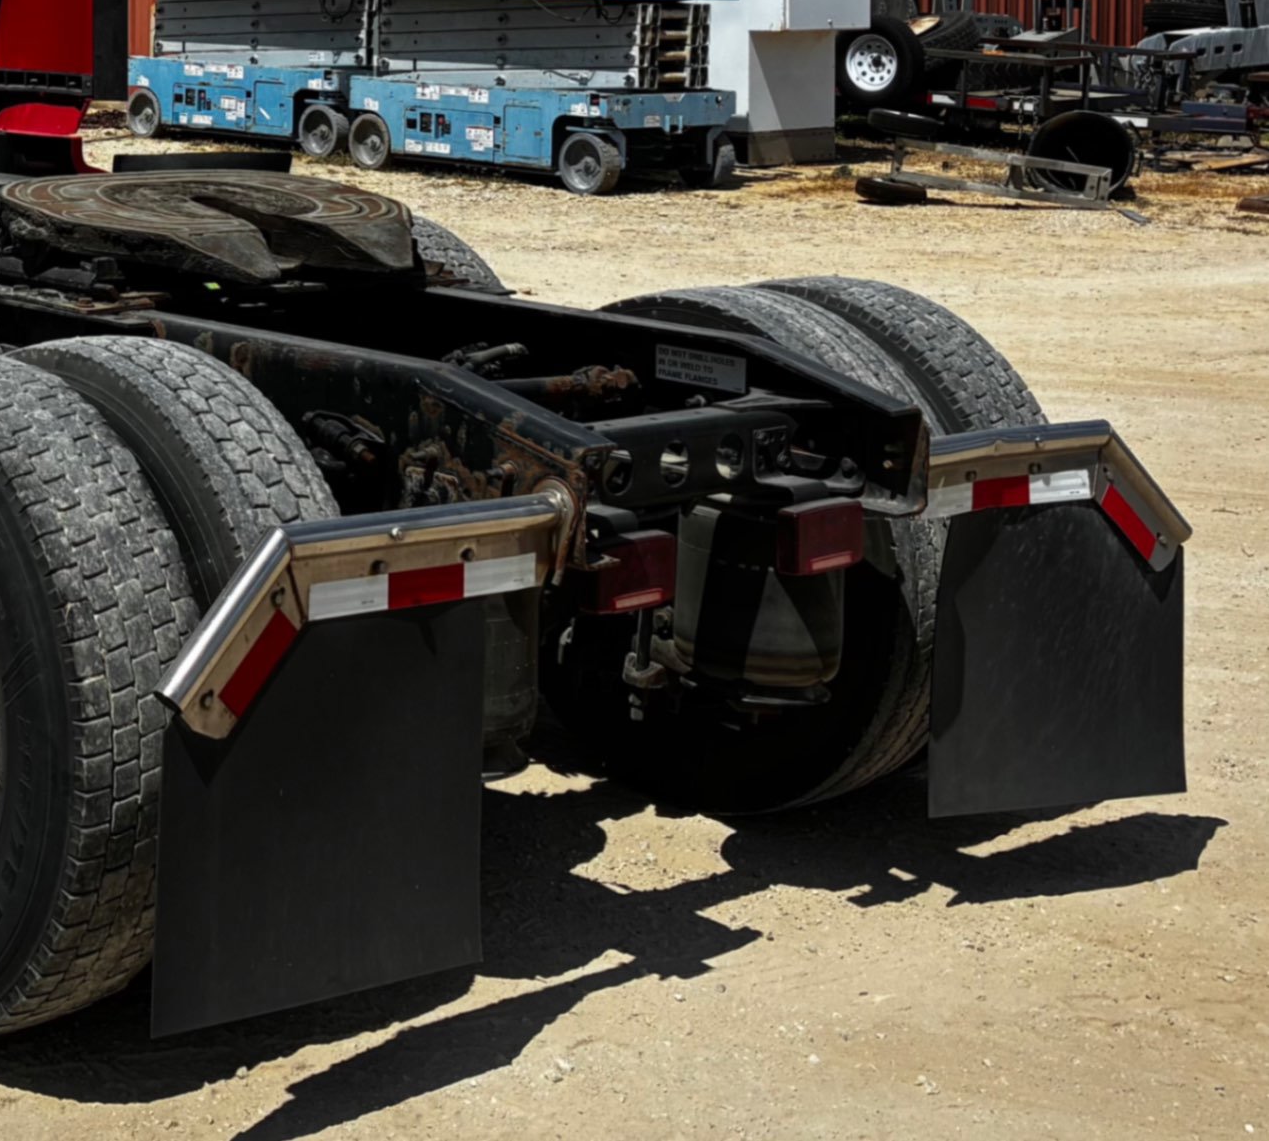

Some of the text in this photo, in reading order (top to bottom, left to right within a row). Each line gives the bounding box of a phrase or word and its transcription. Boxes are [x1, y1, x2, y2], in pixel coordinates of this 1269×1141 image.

[658, 346, 669, 356] DO
[671, 349, 686, 358] NOT
[667, 359, 678, 367] OR
[680, 361, 701, 371] WELD
[703, 365, 714, 374] TO
[658, 368, 718, 386] FRAME FLANGES
